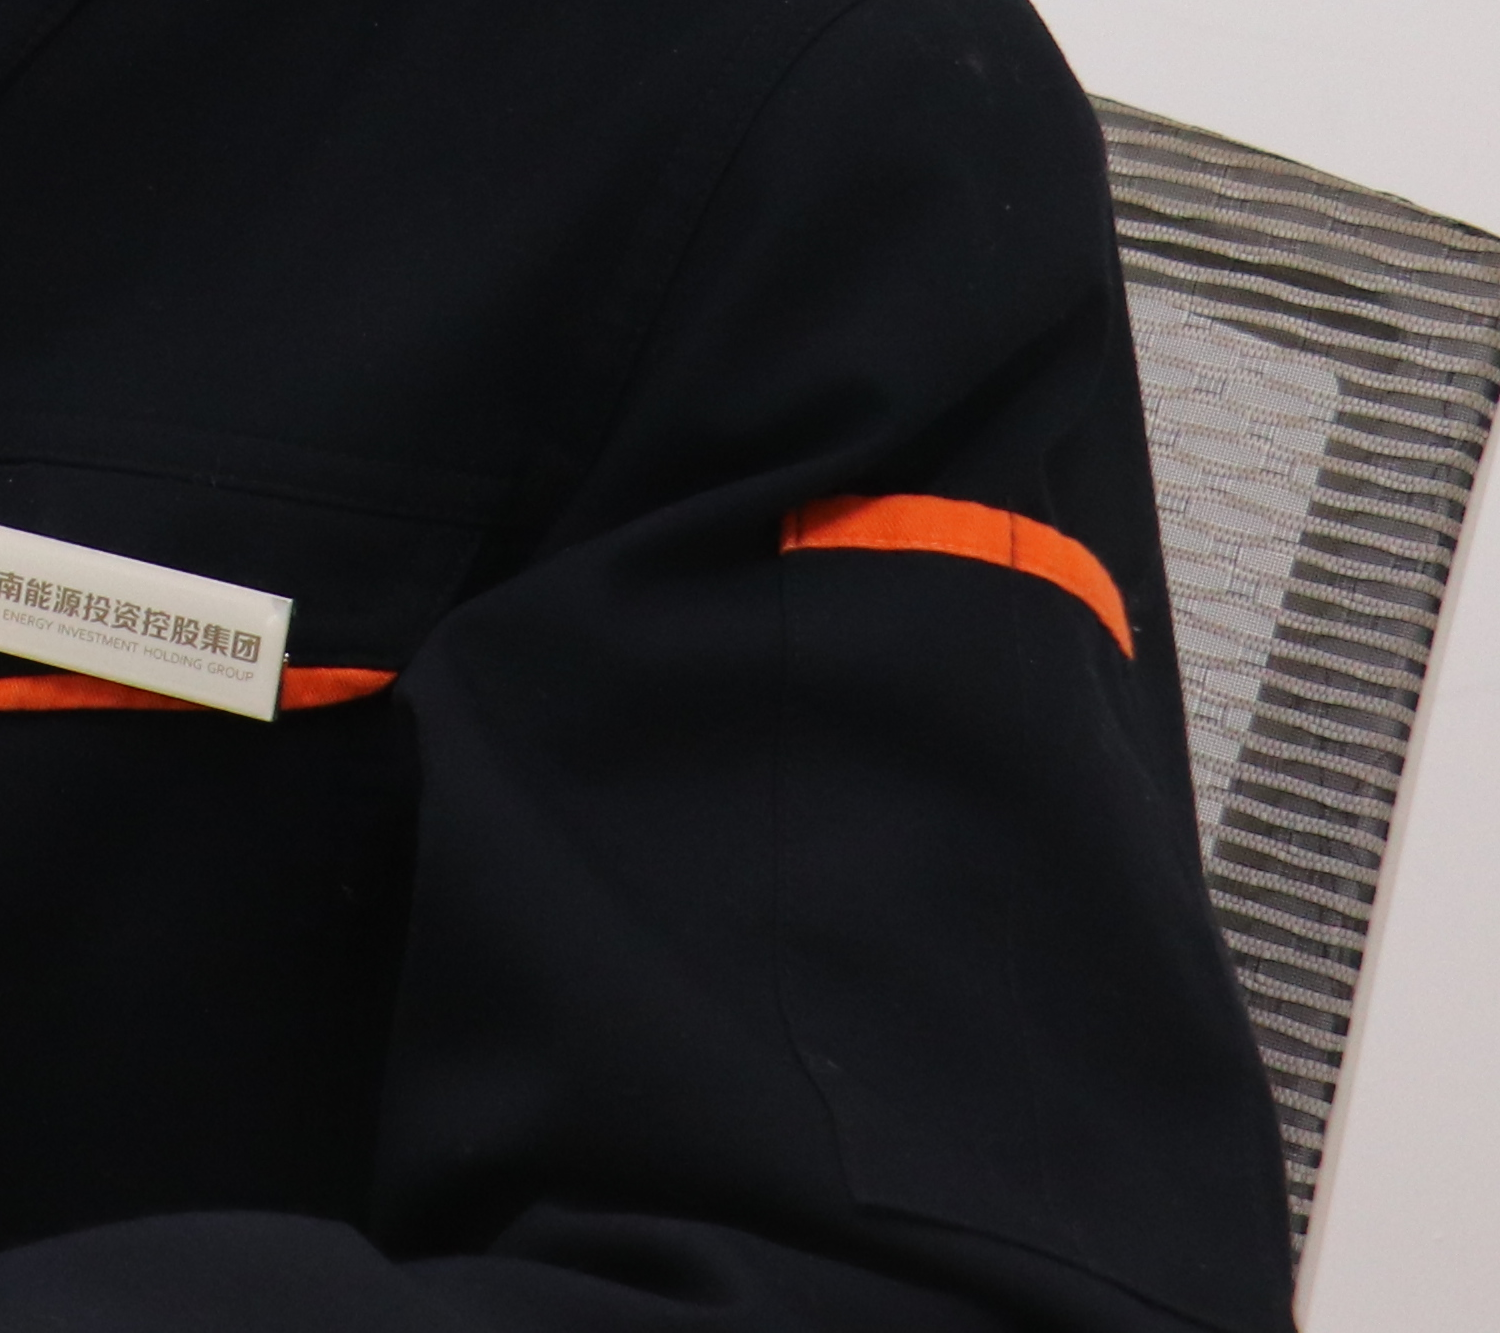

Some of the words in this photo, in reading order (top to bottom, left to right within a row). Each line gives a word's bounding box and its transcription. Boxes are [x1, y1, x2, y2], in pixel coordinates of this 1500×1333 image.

[3, 608, 54, 631] ENERGY
[57, 623, 140, 653] INVESTMENT
[143, 645, 203, 671] HOLDING
[207, 661, 255, 682] GROUP
